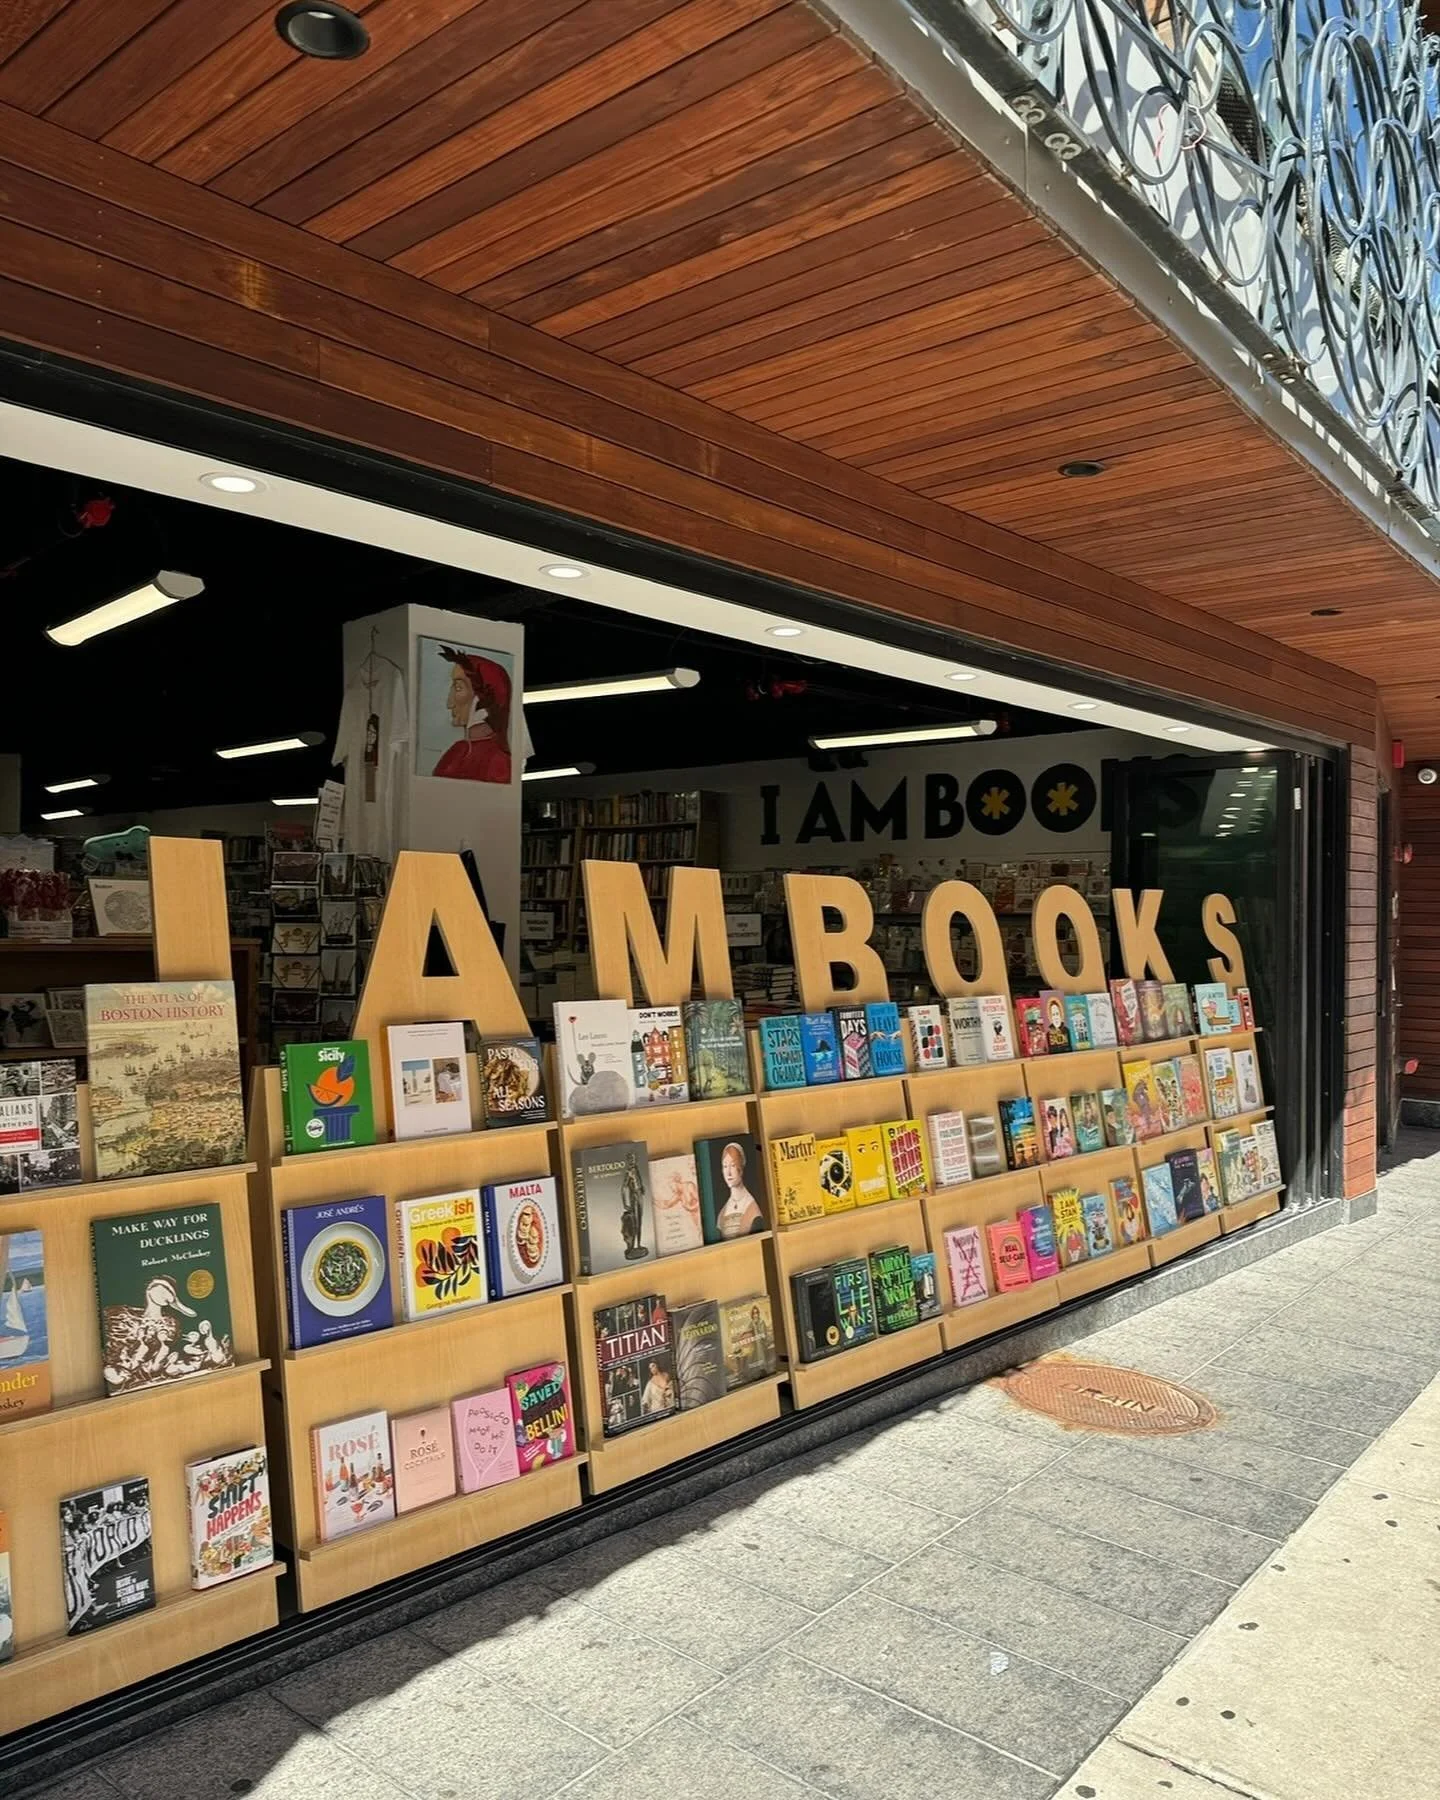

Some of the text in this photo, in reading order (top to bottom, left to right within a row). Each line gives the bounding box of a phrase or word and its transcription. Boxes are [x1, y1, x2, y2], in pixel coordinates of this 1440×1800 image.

[760, 784, 780, 845] I
[795, 774, 908, 844] AM
[149, 836, 235, 982] I
[783, 872, 1248, 1012] BOOKS
[124, 991, 204, 1005] THE ATLAS OF
[101, 1005, 225, 1021] BOSTON HISTORY
[768, 1028, 801, 1049] STARS
[840, 1018, 868, 1040] DAYS
[318, 1049, 346, 1063] Sicily
[487, 1046, 519, 1060] PASTA
[499, 1095, 546, 1112] SEASONS
[780, 1136, 817, 1162] Martyr!
[588, 1160, 626, 1174] BERTOLDO
[509, 1183, 543, 1199] MALTA
[335, 1204, 365, 1218] ANDRÉS
[409, 1199, 474, 1224] Greekish
[112, 1213, 208, 1236] MAKE WAY FOR
[140, 1229, 210, 1249] DUCKLINGS
[1004, 1244, 1018, 1253] REAL
[141, 1257, 168, 1267] Robert
[835, 1269, 868, 1290] FIRST
[836, 1284, 871, 1316] LIE
[840, 1308, 873, 1331] WINS
[606, 1324, 667, 1359] TITIAN
[522, 1380, 562, 1411] SAVED
[1060, 1382, 1158, 1414] DRAIN
[525, 1404, 570, 1441] BELLINI
[206, 1491, 263, 1541] HAPPENS
